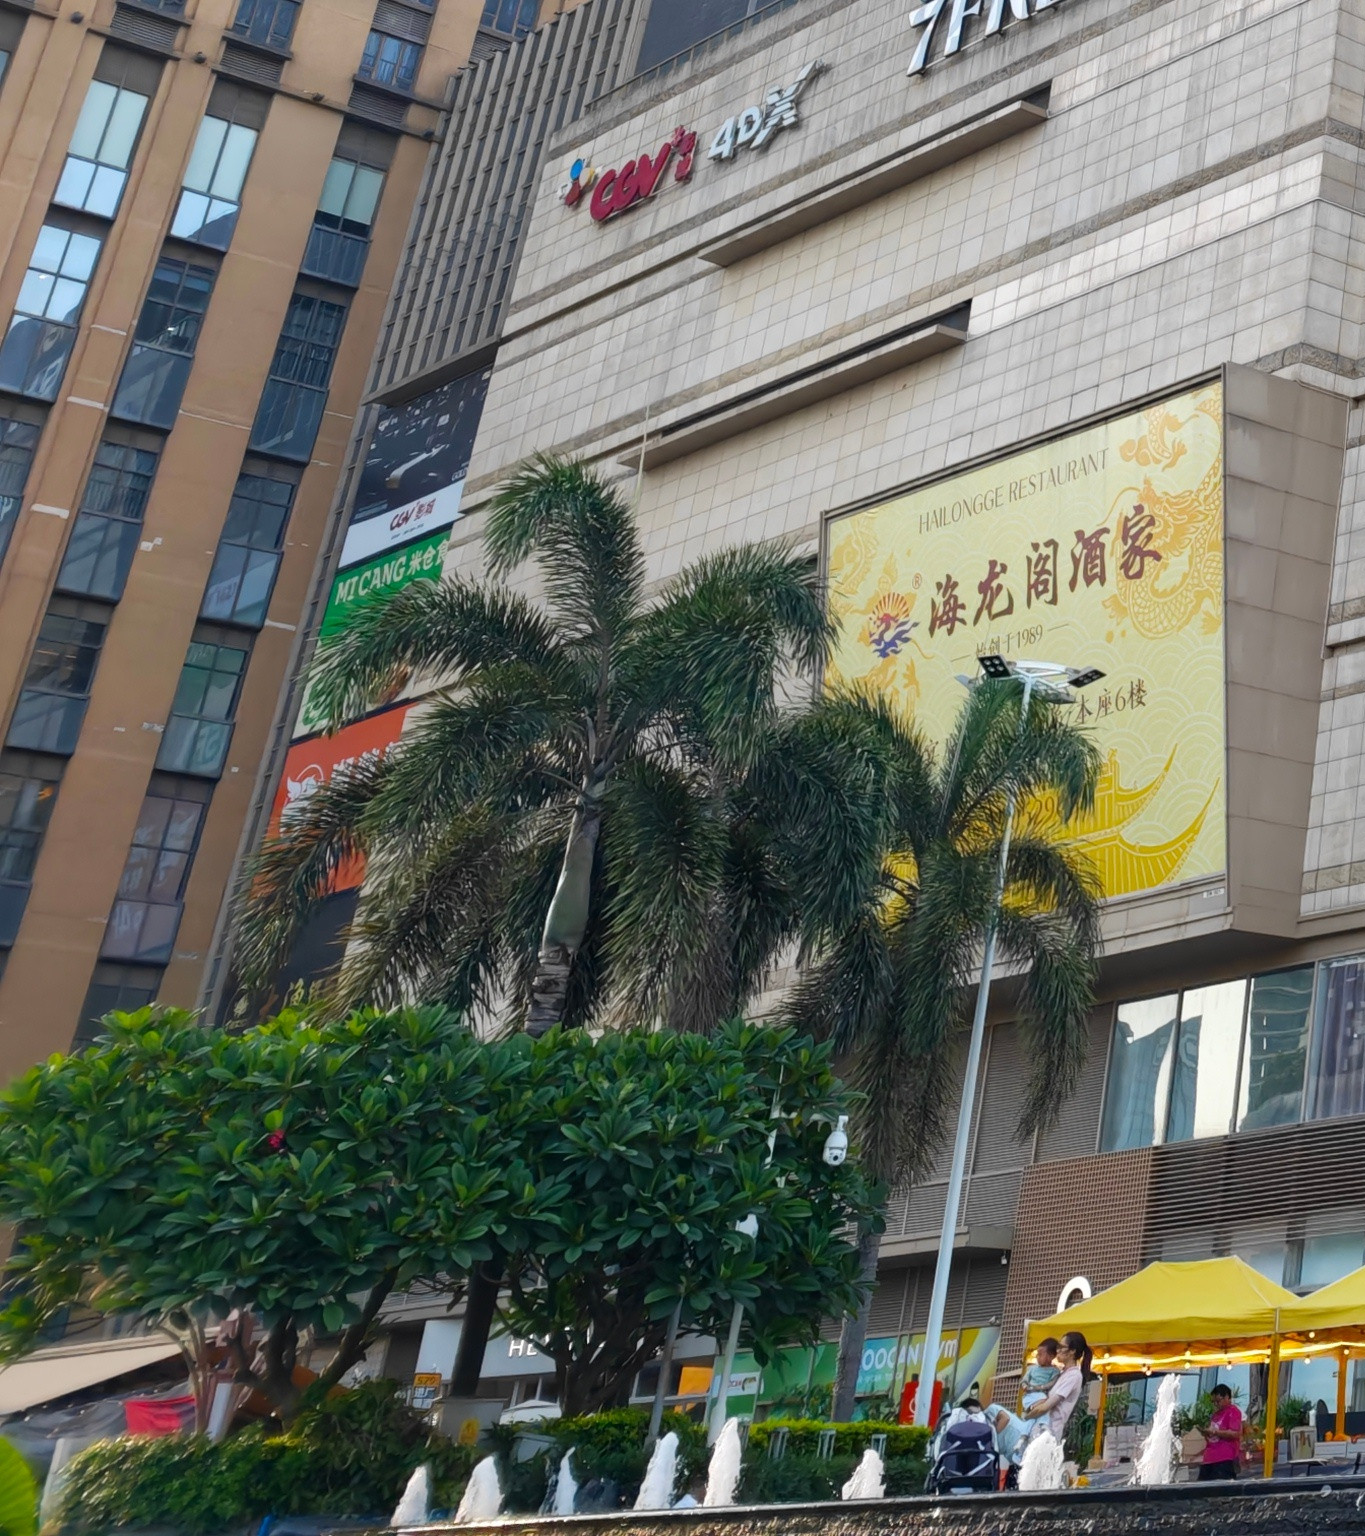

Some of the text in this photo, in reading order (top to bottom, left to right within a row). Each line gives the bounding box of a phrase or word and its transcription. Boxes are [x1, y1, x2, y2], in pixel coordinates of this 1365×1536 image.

[590, 142, 672, 222] CGV
[918, 448, 1110, 535] HAILONGGE RESTAURANT
[928, 504, 1163, 638] 海龙阁酒家
